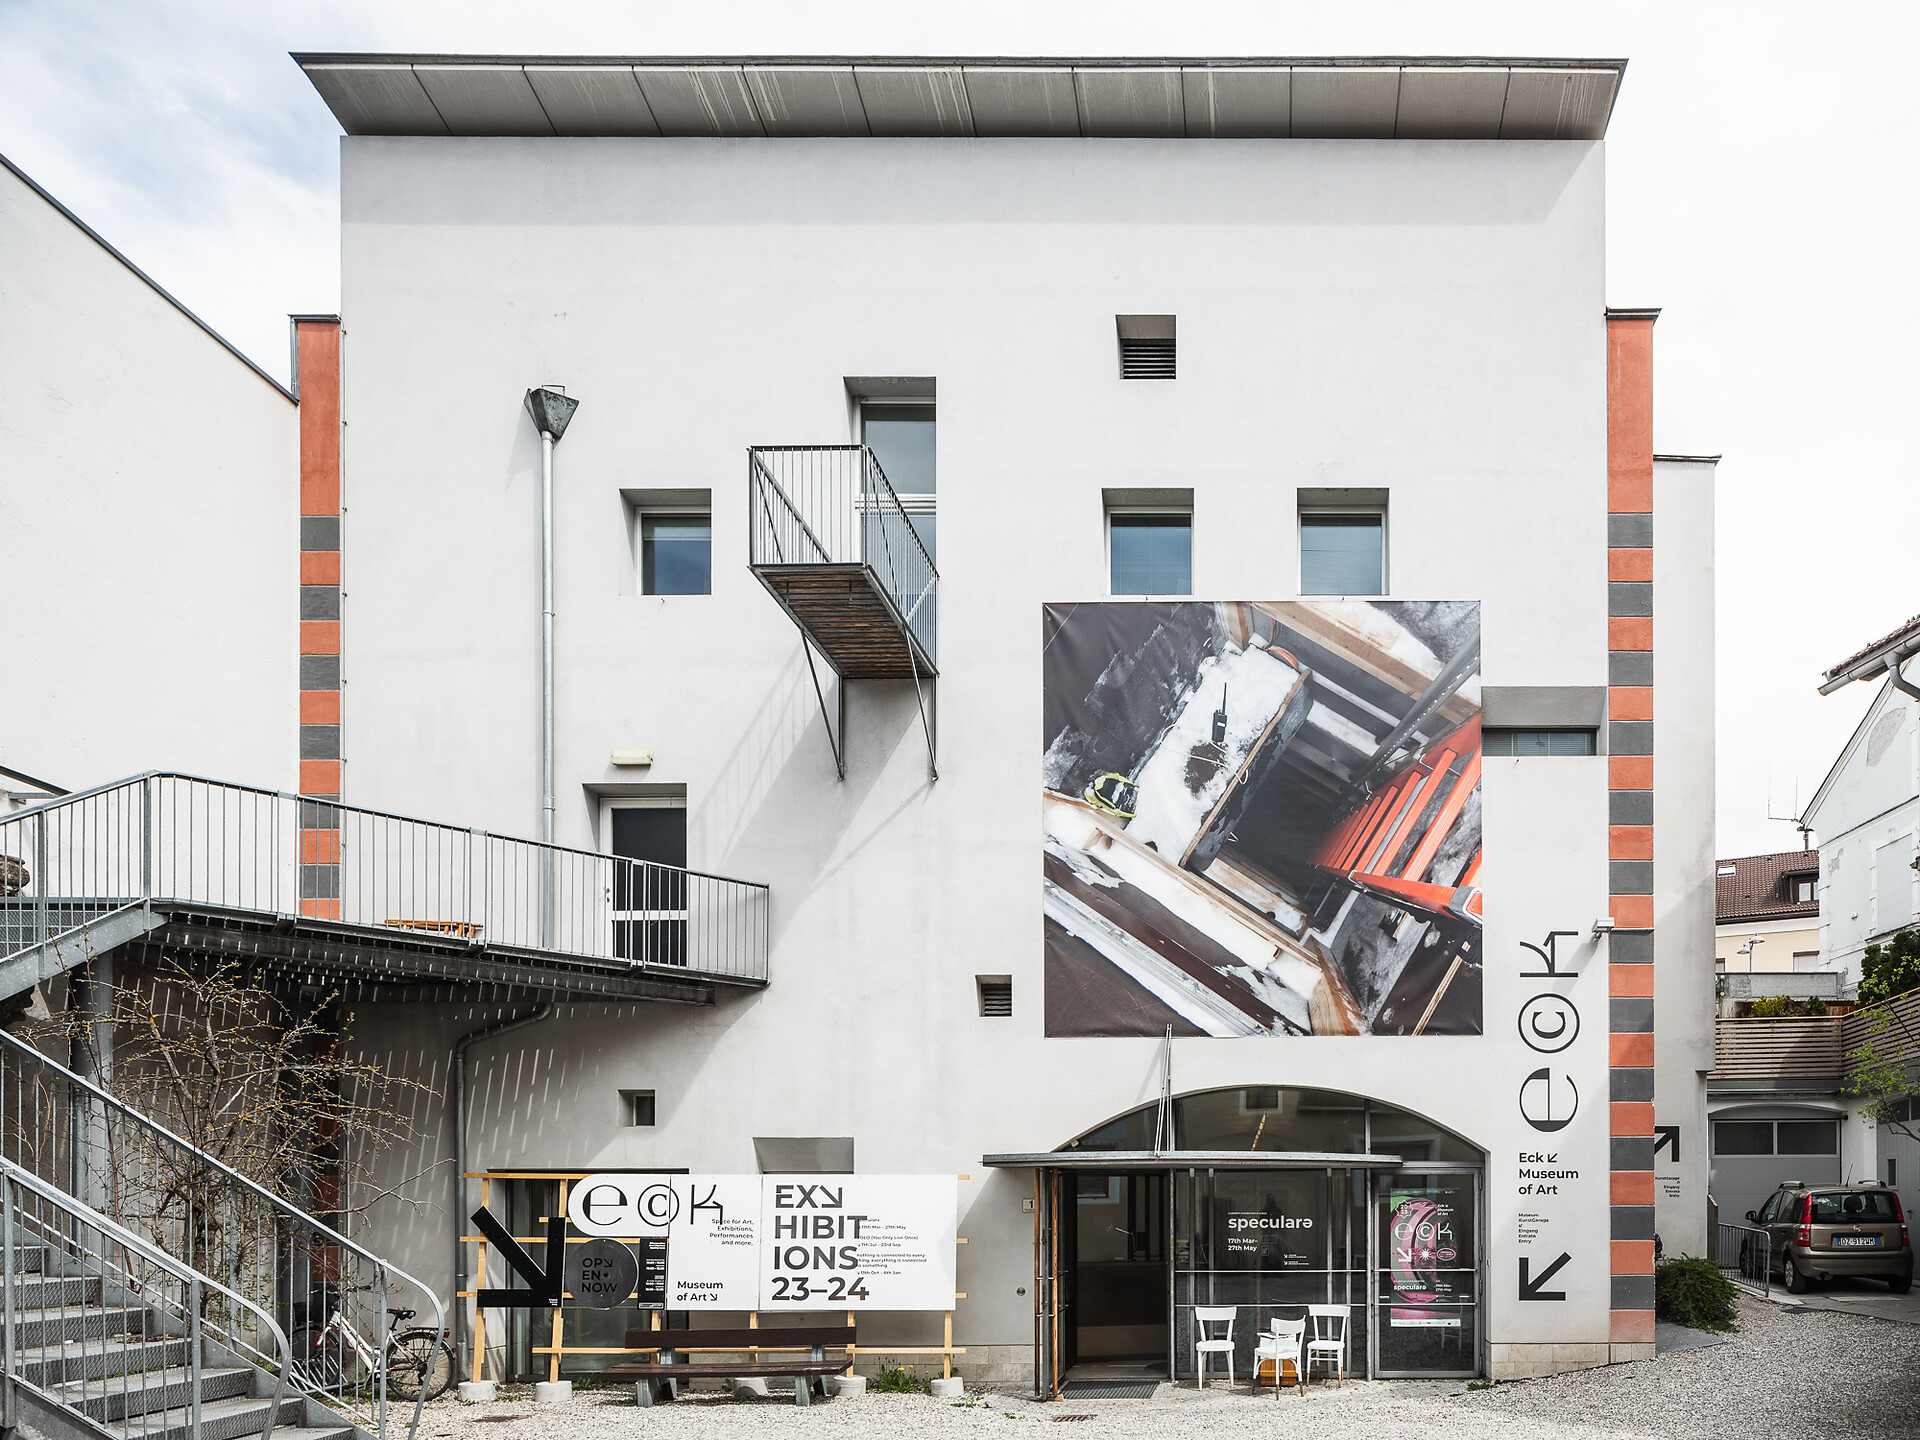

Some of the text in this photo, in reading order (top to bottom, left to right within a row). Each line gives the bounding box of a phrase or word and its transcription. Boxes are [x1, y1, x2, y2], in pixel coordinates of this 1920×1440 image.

[1518, 1151, 1544, 1163] Eck
[1518, 1168, 1579, 1179] Museum
[1518, 1184, 1558, 1195] of Art
[774, 1215, 868, 1239] HIBIT
[774, 1245, 859, 1270] IONS
[581, 1282, 618, 1293] NOW
[677, 1280, 724, 1289] Museum
[676, 1293, 707, 1301] of Art
